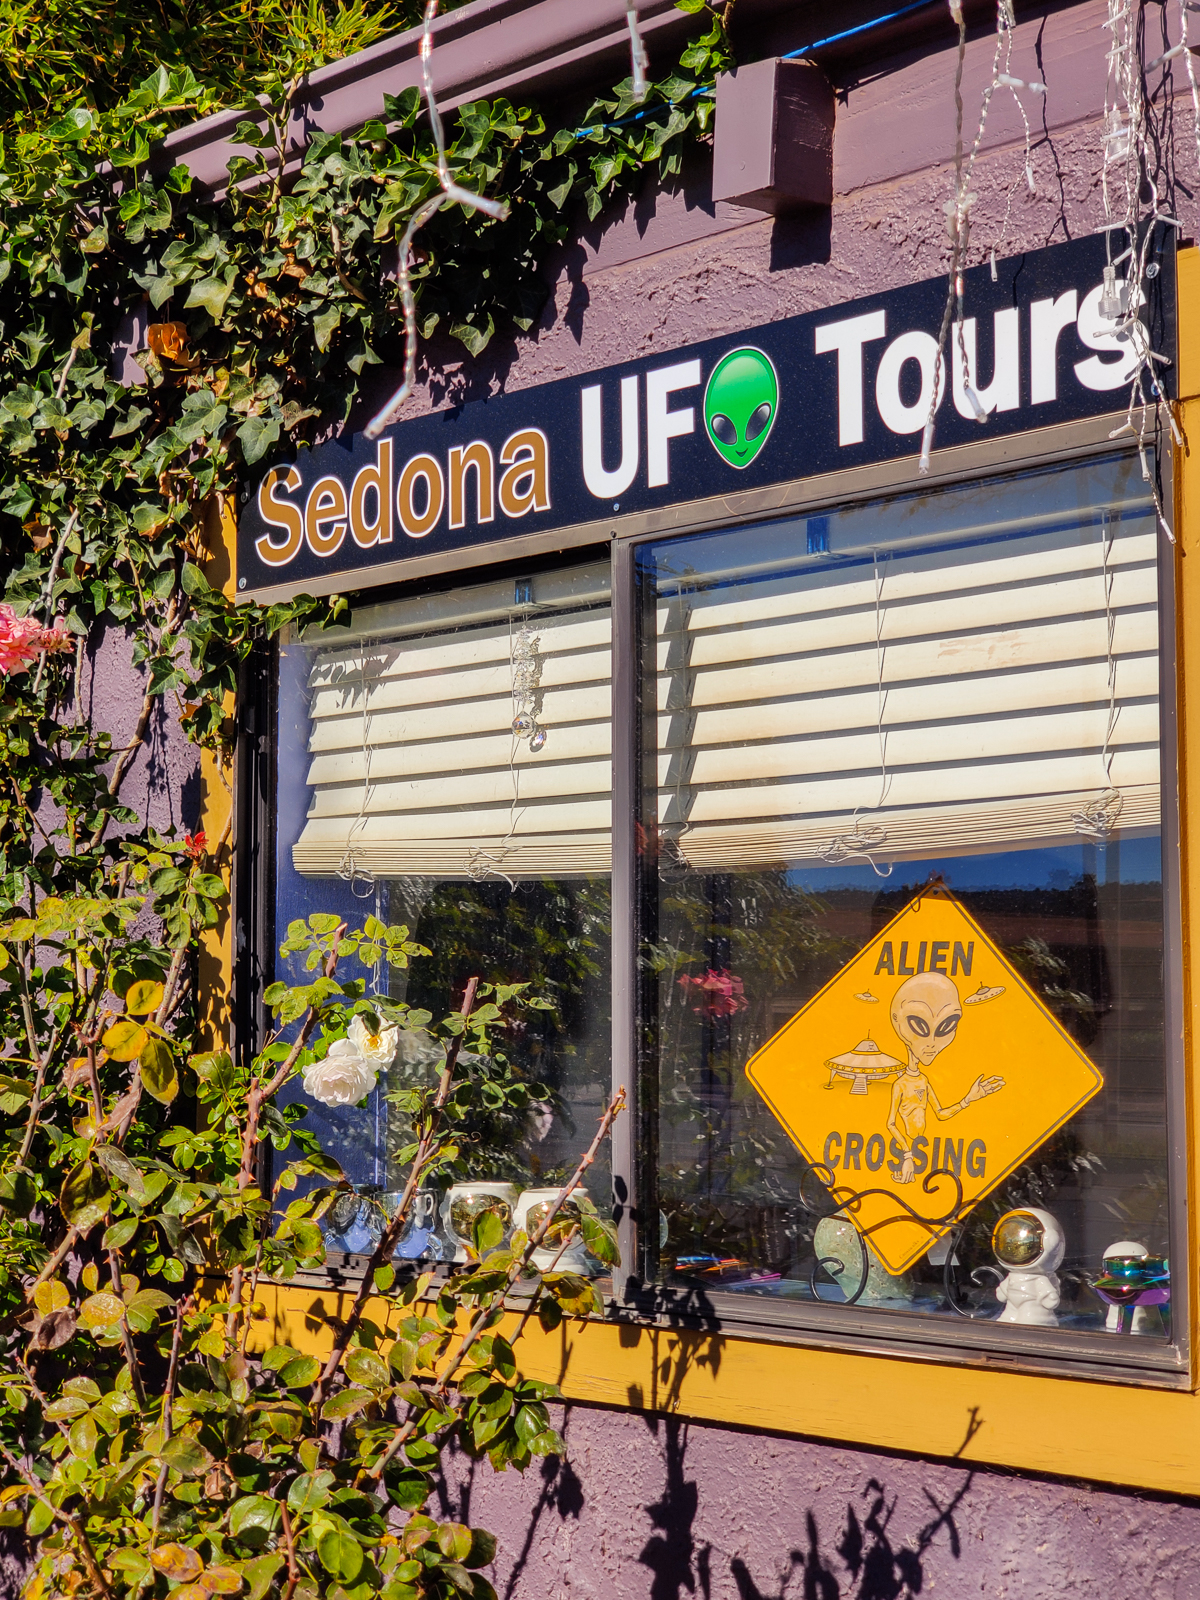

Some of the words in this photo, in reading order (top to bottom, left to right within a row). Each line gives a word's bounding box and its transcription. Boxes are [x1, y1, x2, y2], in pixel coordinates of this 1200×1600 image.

[254, 427, 551, 567] Sedona
[814, 279, 1150, 447] Tours
[873, 941, 975, 977] ALIEN
[823, 1131, 987, 1178] CROSSING
